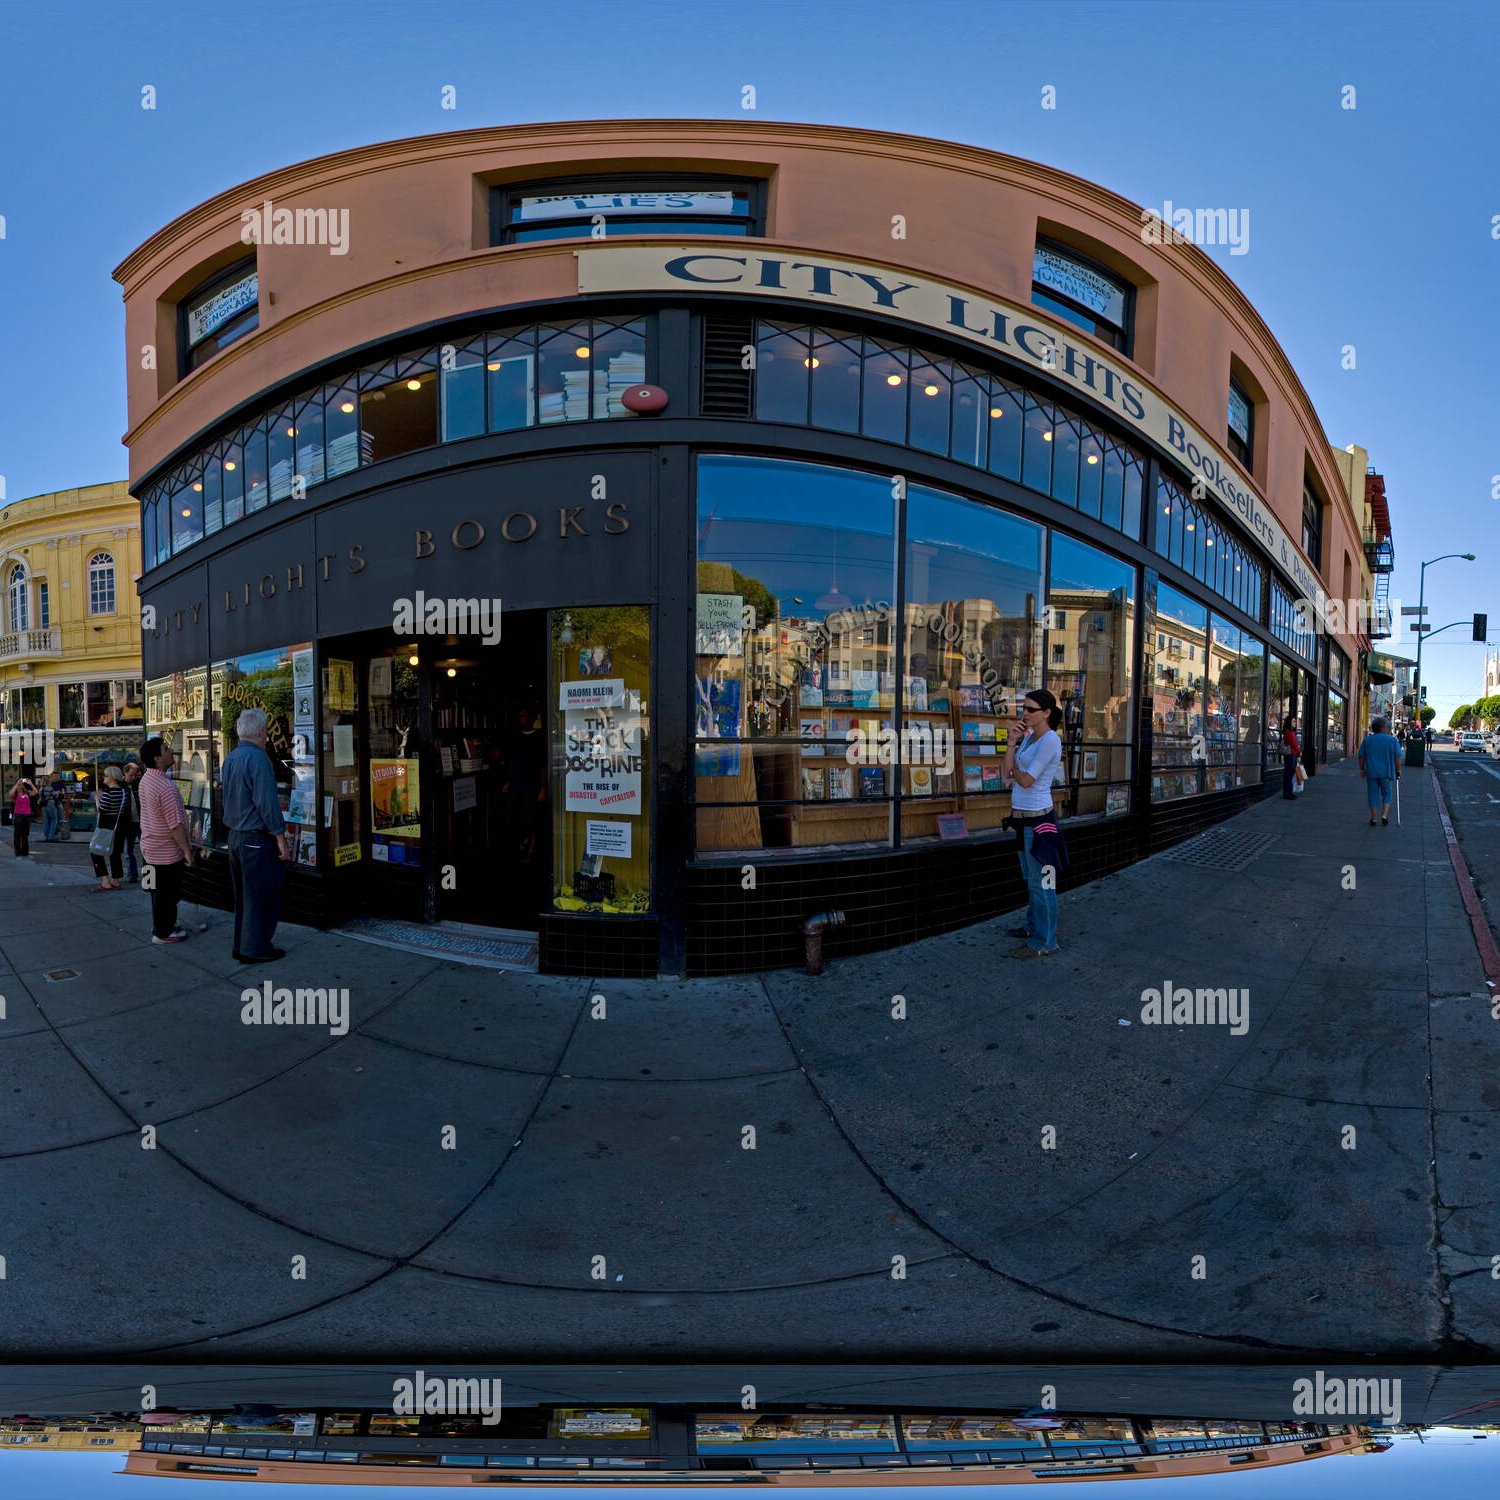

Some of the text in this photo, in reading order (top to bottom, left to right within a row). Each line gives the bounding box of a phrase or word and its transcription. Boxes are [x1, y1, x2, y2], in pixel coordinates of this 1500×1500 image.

[574, 196, 693, 210] LIES
[1033, 268, 1108, 313] HUMANITY
[664, 255, 919, 309] CITY
[946, 293, 1145, 421] LIGHTS
[1167, 412, 1274, 547] Booksellers
[1281, 538, 1289, 567] &
[226, 544, 366, 613] LIGHTS
[414, 503, 630, 559] BOOKS
[707, 598, 733, 608] STASH
[708, 608, 731, 619] YOUR
[567, 686, 613, 698] NAOMI KLEIN
[584, 717, 615, 730] THE
[568, 730, 632, 755] SHCK
[596, 783, 609, 791] RISE
[612, 783, 620, 791] OF
[569, 790, 636, 806] DISASTER CAPITALISM
